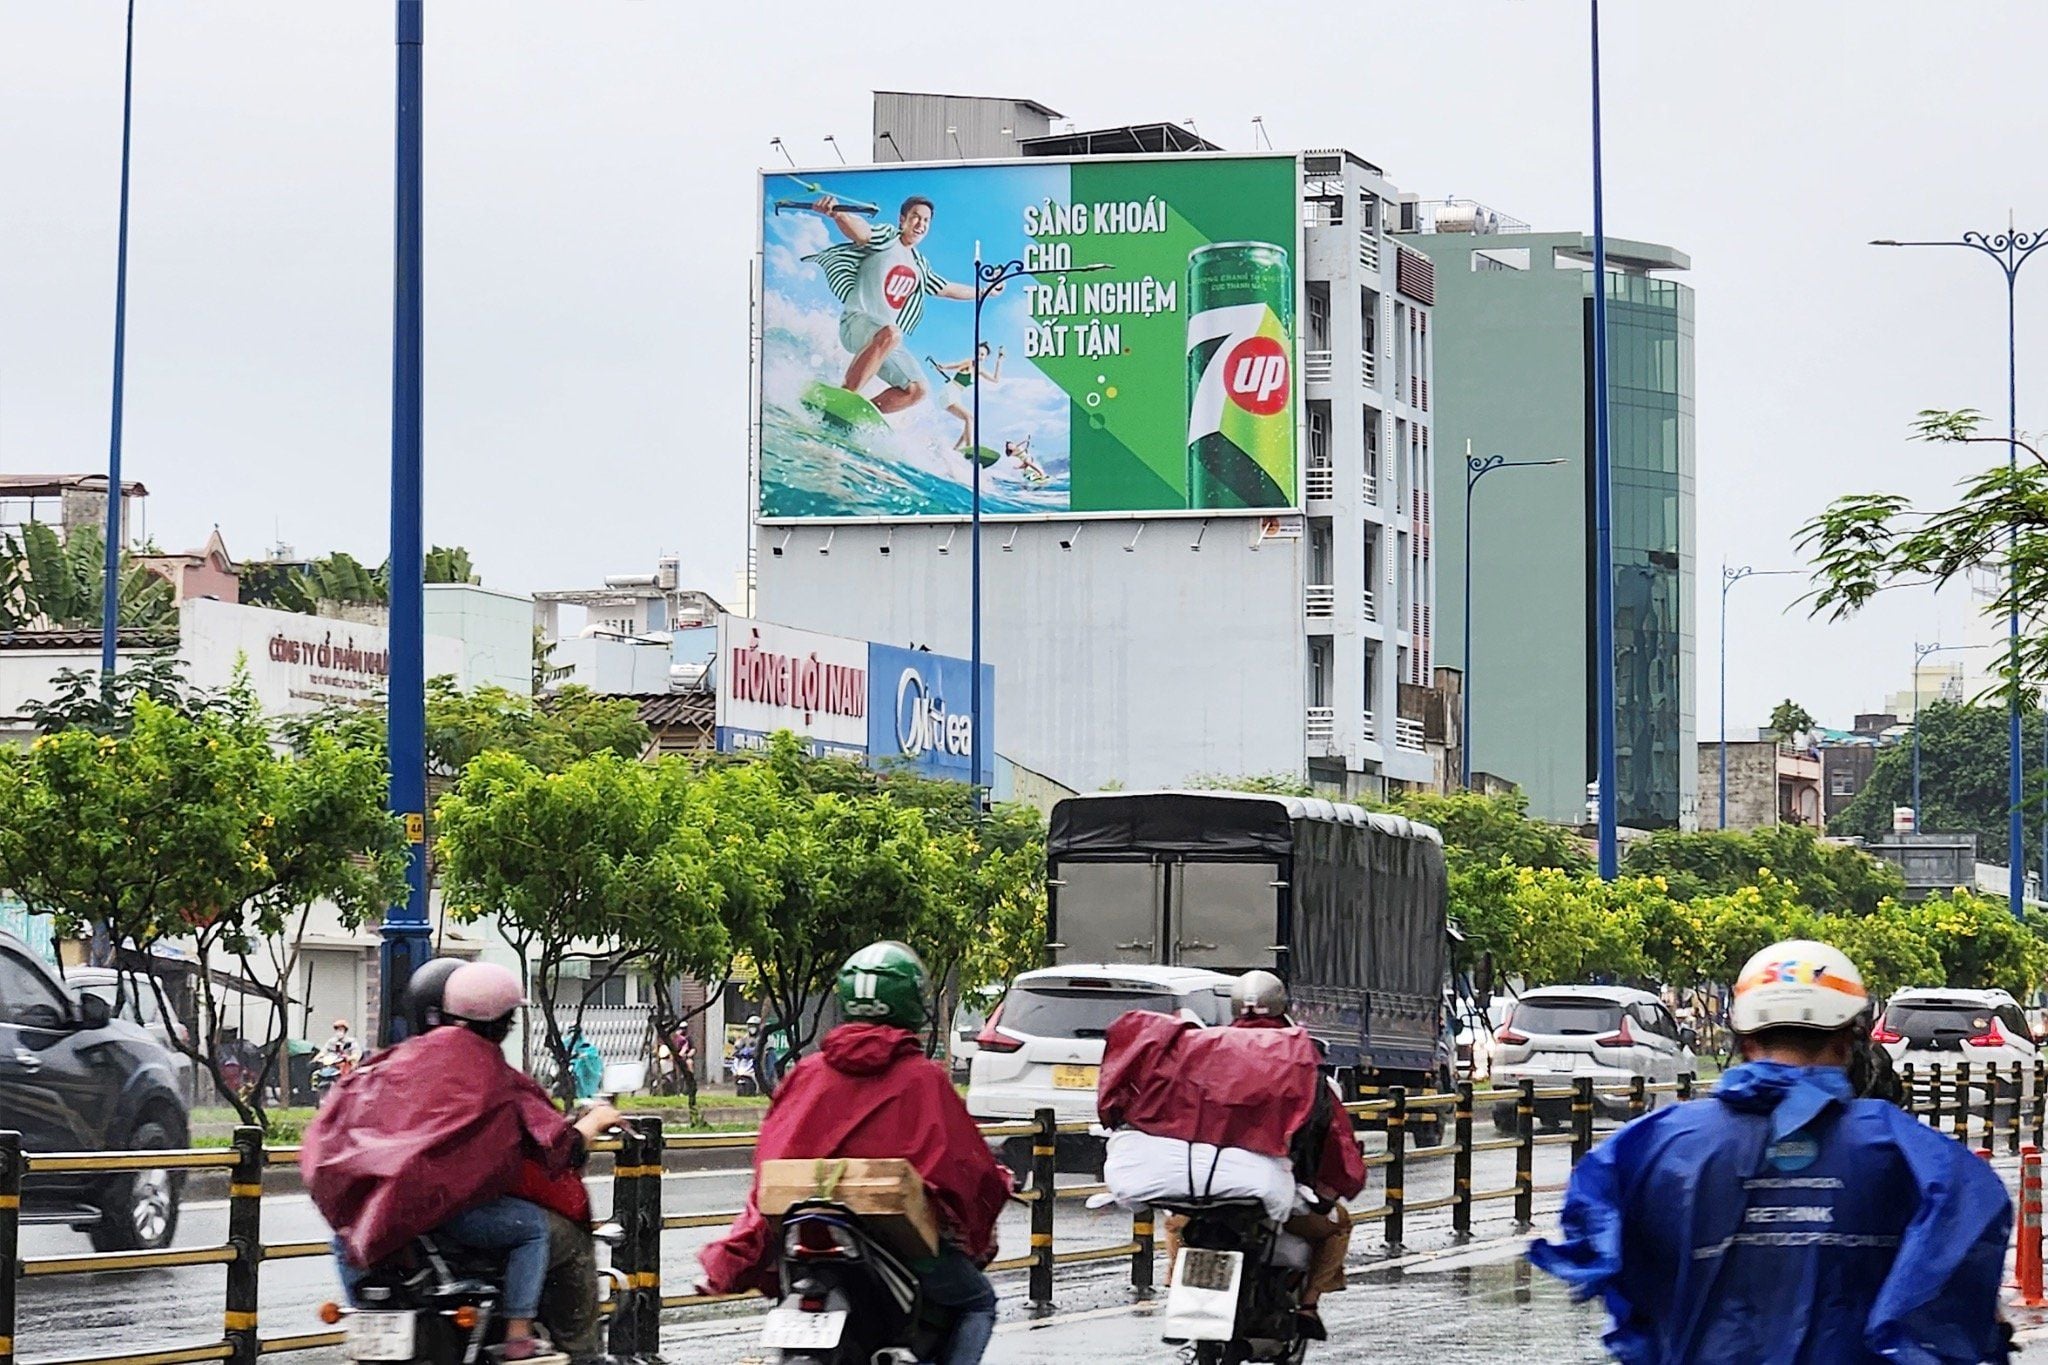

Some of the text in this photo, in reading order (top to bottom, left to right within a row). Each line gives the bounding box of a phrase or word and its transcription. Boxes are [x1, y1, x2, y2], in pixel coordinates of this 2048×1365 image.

[1023, 195, 1167, 237] SẢNG KHOÁI
[1023, 243, 1072, 272] CHO
[1023, 275, 1176, 318] TRẢI NGHIỆM
[1023, 318, 1121, 361] BẤT TẬN
[302, 642, 316, 666] TY
[733, 628, 866, 726] HỒNG LỢI NAM
